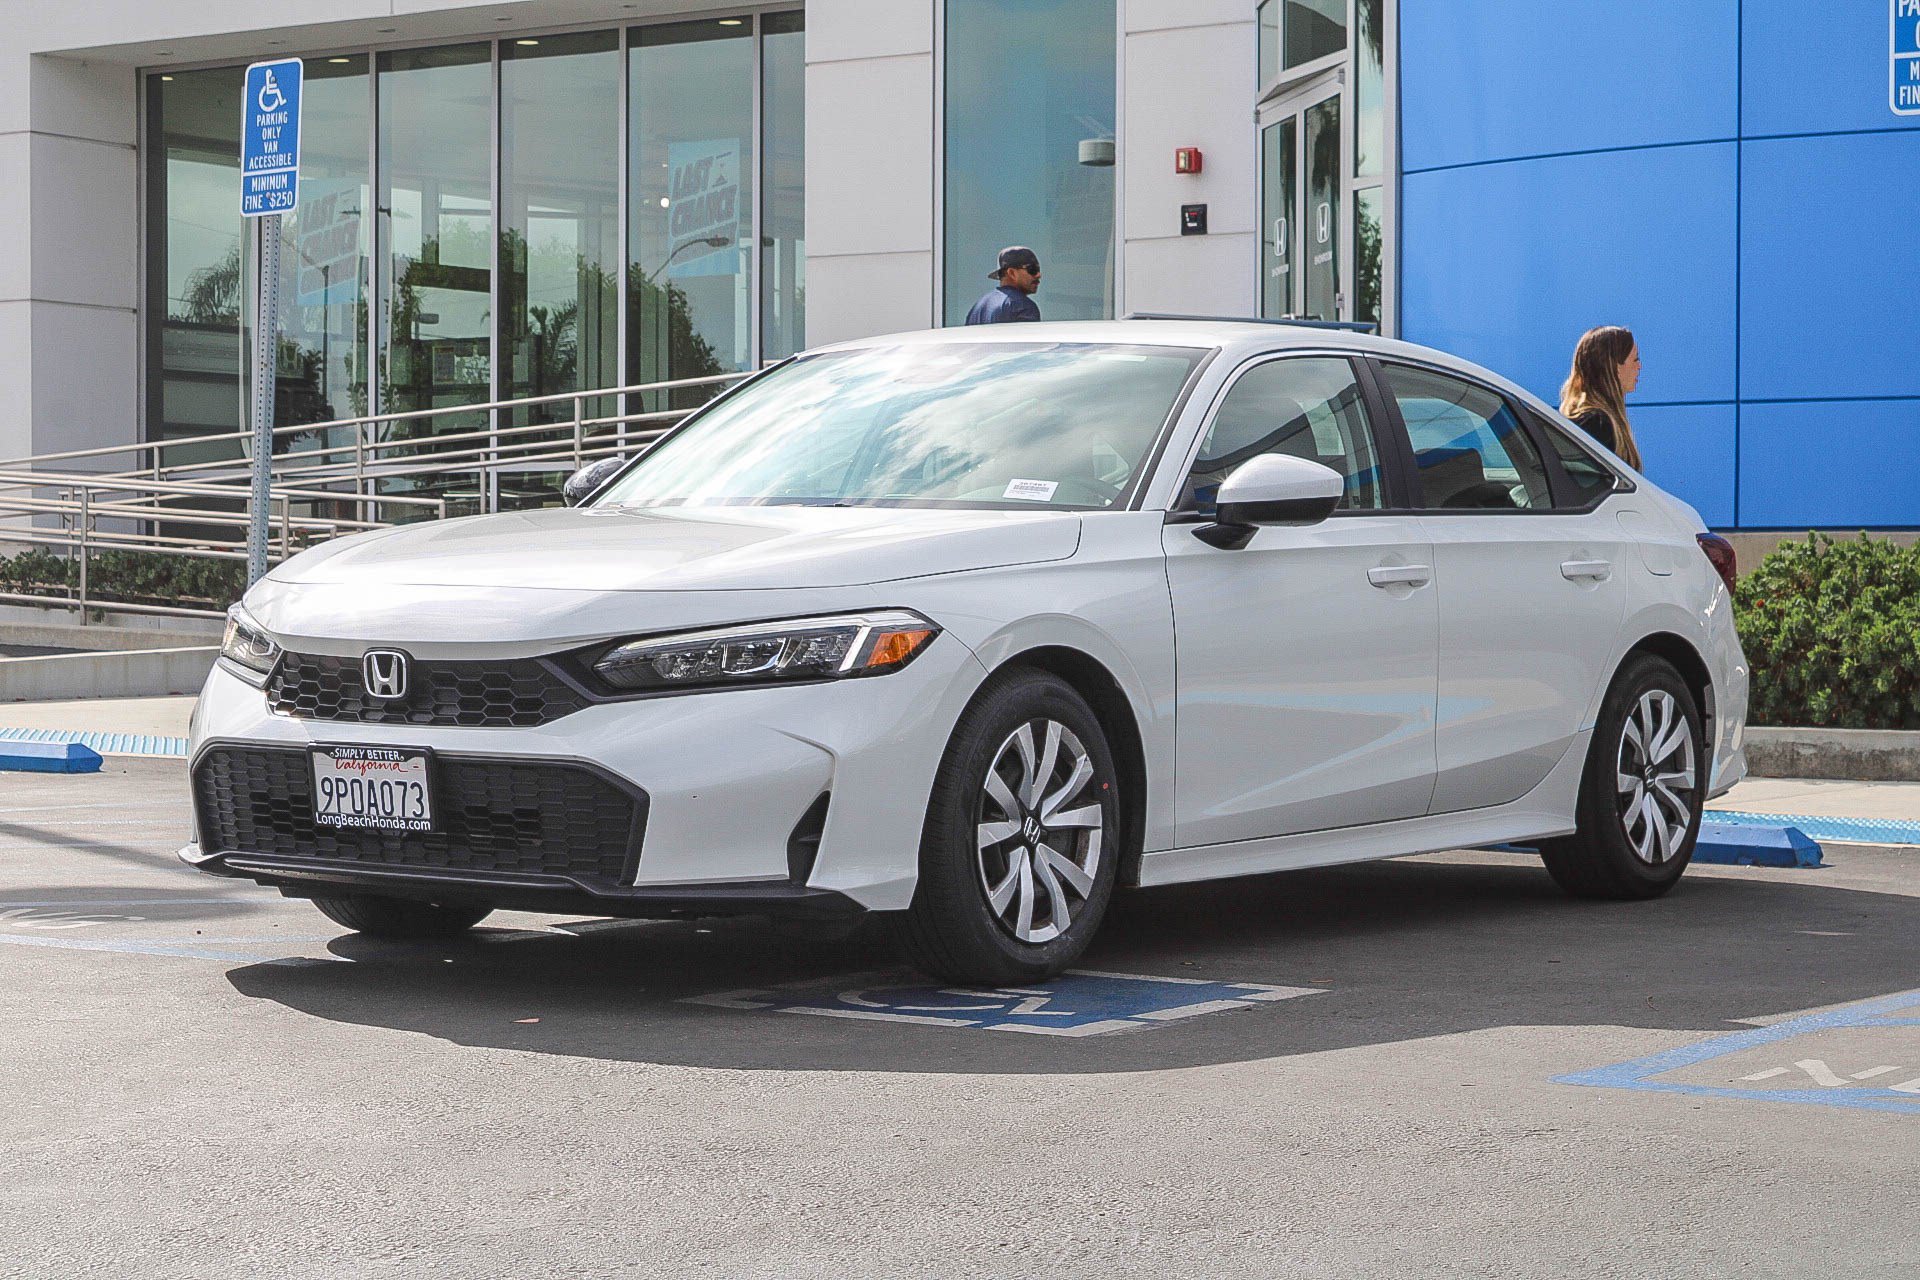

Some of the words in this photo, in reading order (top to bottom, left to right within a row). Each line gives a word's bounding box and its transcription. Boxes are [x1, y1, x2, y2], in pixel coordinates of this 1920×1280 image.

[256, 111, 288, 127] PARKING
[262, 126, 281, 140] ONLY
[264, 140, 278, 153] VAN
[248, 153, 292, 170] ACCESSIBLE
[251, 174, 288, 192] MINIMUM
[245, 194, 263, 210] FINE
[269, 191, 293, 209] $250
[334, 747, 365, 759] SIMPLY
[366, 750, 400, 760] BETTER
[335, 759, 408, 776] California
[315, 812, 431, 831] LongBeachHonda.com
